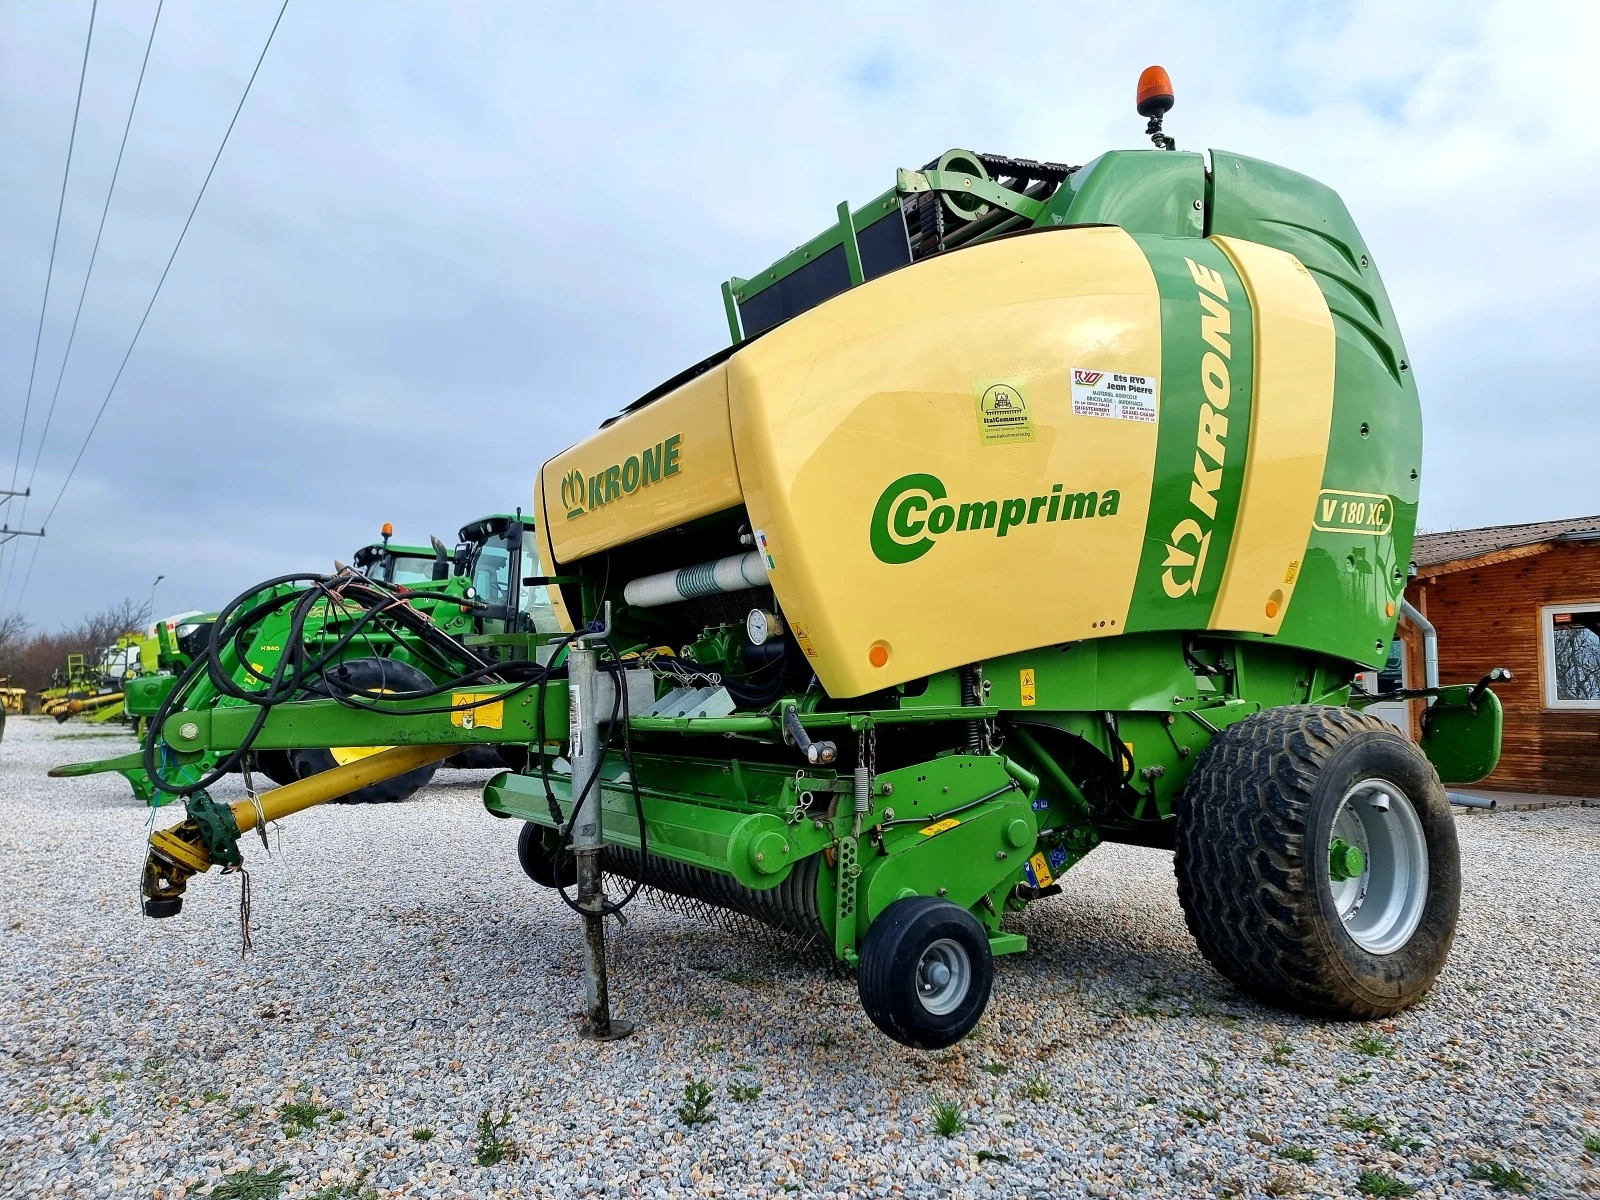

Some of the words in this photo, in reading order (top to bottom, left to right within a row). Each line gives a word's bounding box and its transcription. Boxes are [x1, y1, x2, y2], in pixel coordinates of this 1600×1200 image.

[1113, 374, 1128, 383] Ets
[1129, 376, 1146, 385] RYO
[1106, 382, 1127, 392] Jean
[1128, 384, 1153, 395] Pierre
[1184, 257, 1231, 521] KRONE
[1086, 395, 1113, 404] BRICOLAGE
[1115, 392, 1138, 400] AGRICOLE
[983, 416, 1028, 424] ItalCommerce
[588, 432, 683, 512] KRONE
[870, 473, 1121, 565] Comprima
[1322, 499, 1338, 522] V
[1341, 501, 1366, 525] 180
[1366, 503, 1386, 526] XC
